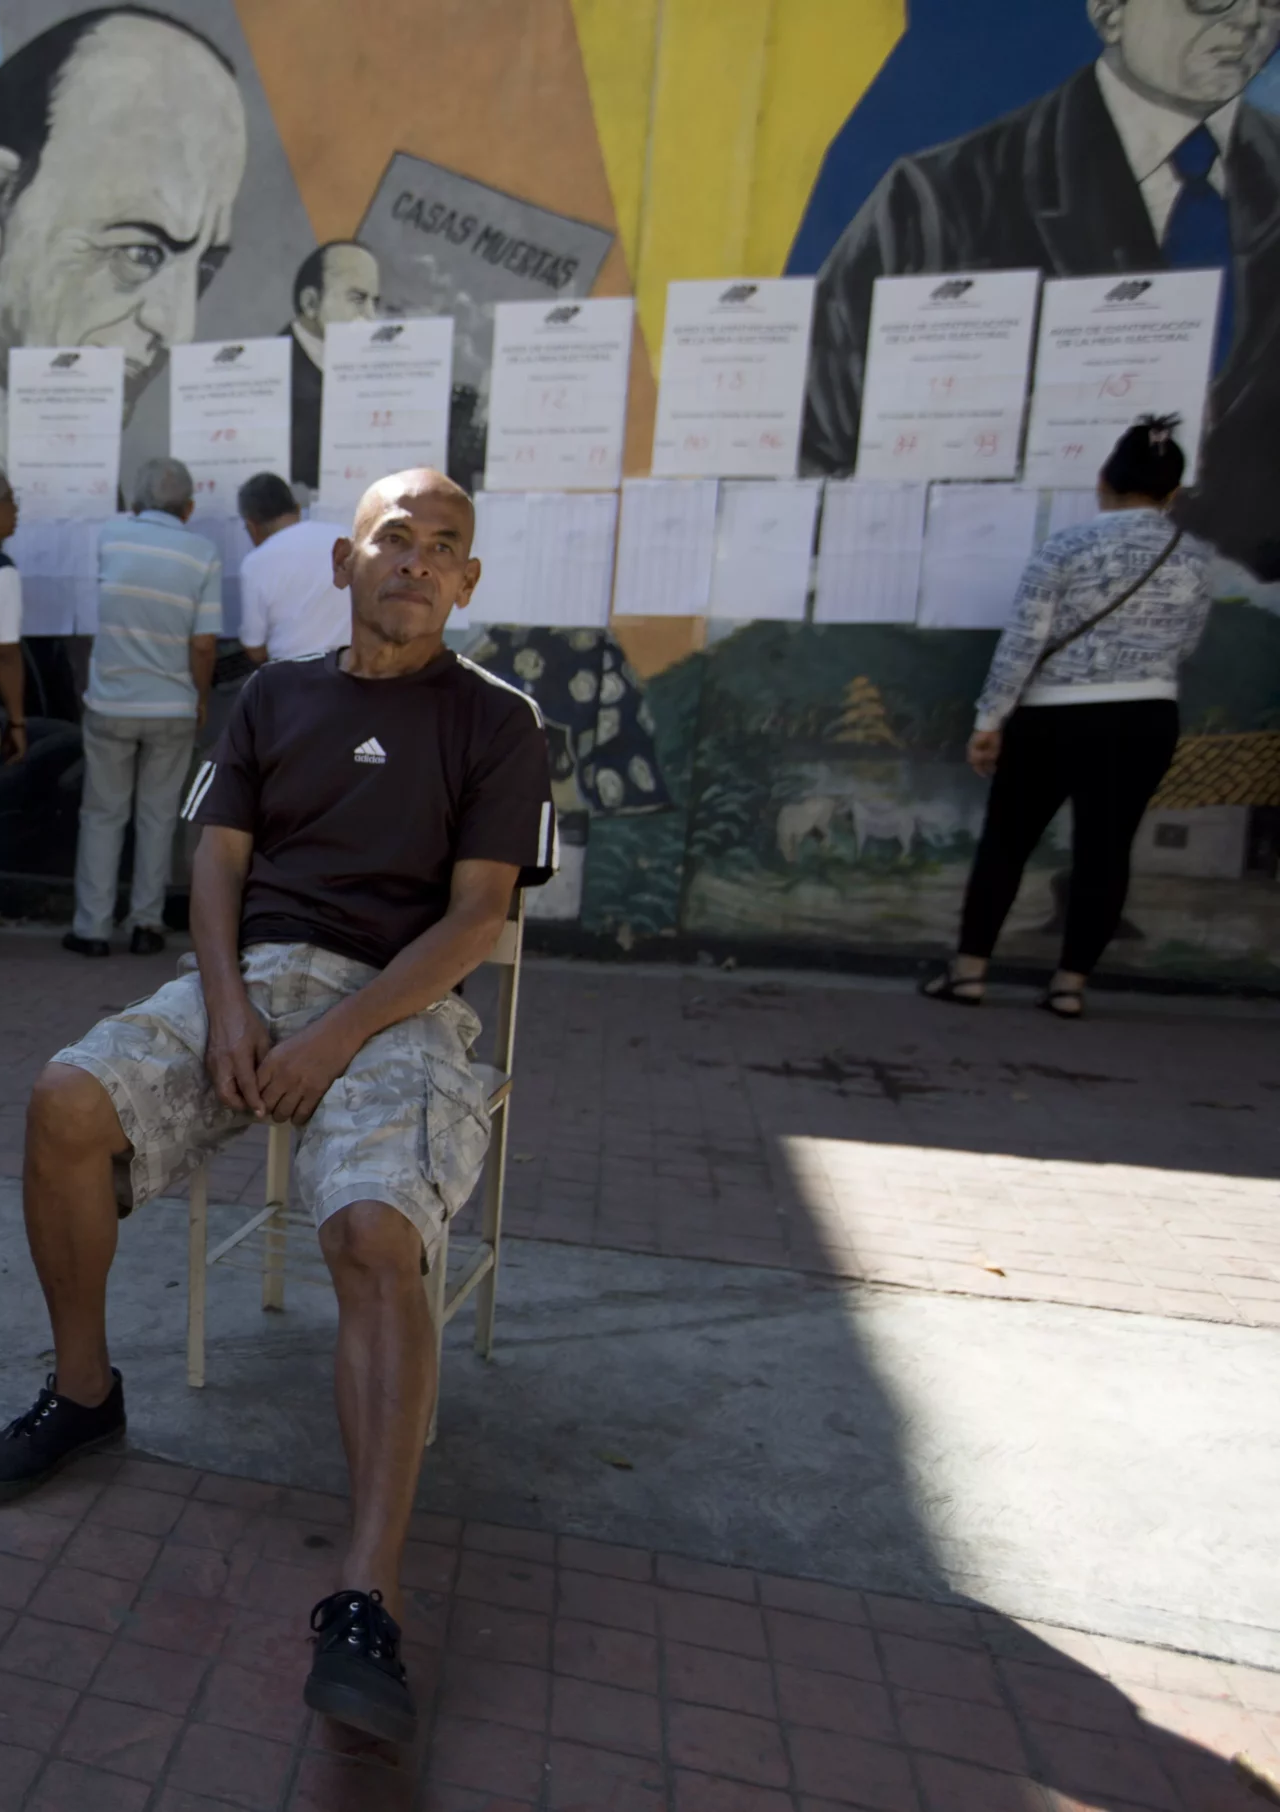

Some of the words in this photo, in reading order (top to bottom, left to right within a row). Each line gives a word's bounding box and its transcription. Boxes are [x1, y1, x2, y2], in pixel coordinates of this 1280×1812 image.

[390, 191, 478, 245] CASAS
[471, 225, 579, 290] MUERTAS
[1097, 373, 1141, 400] 15
